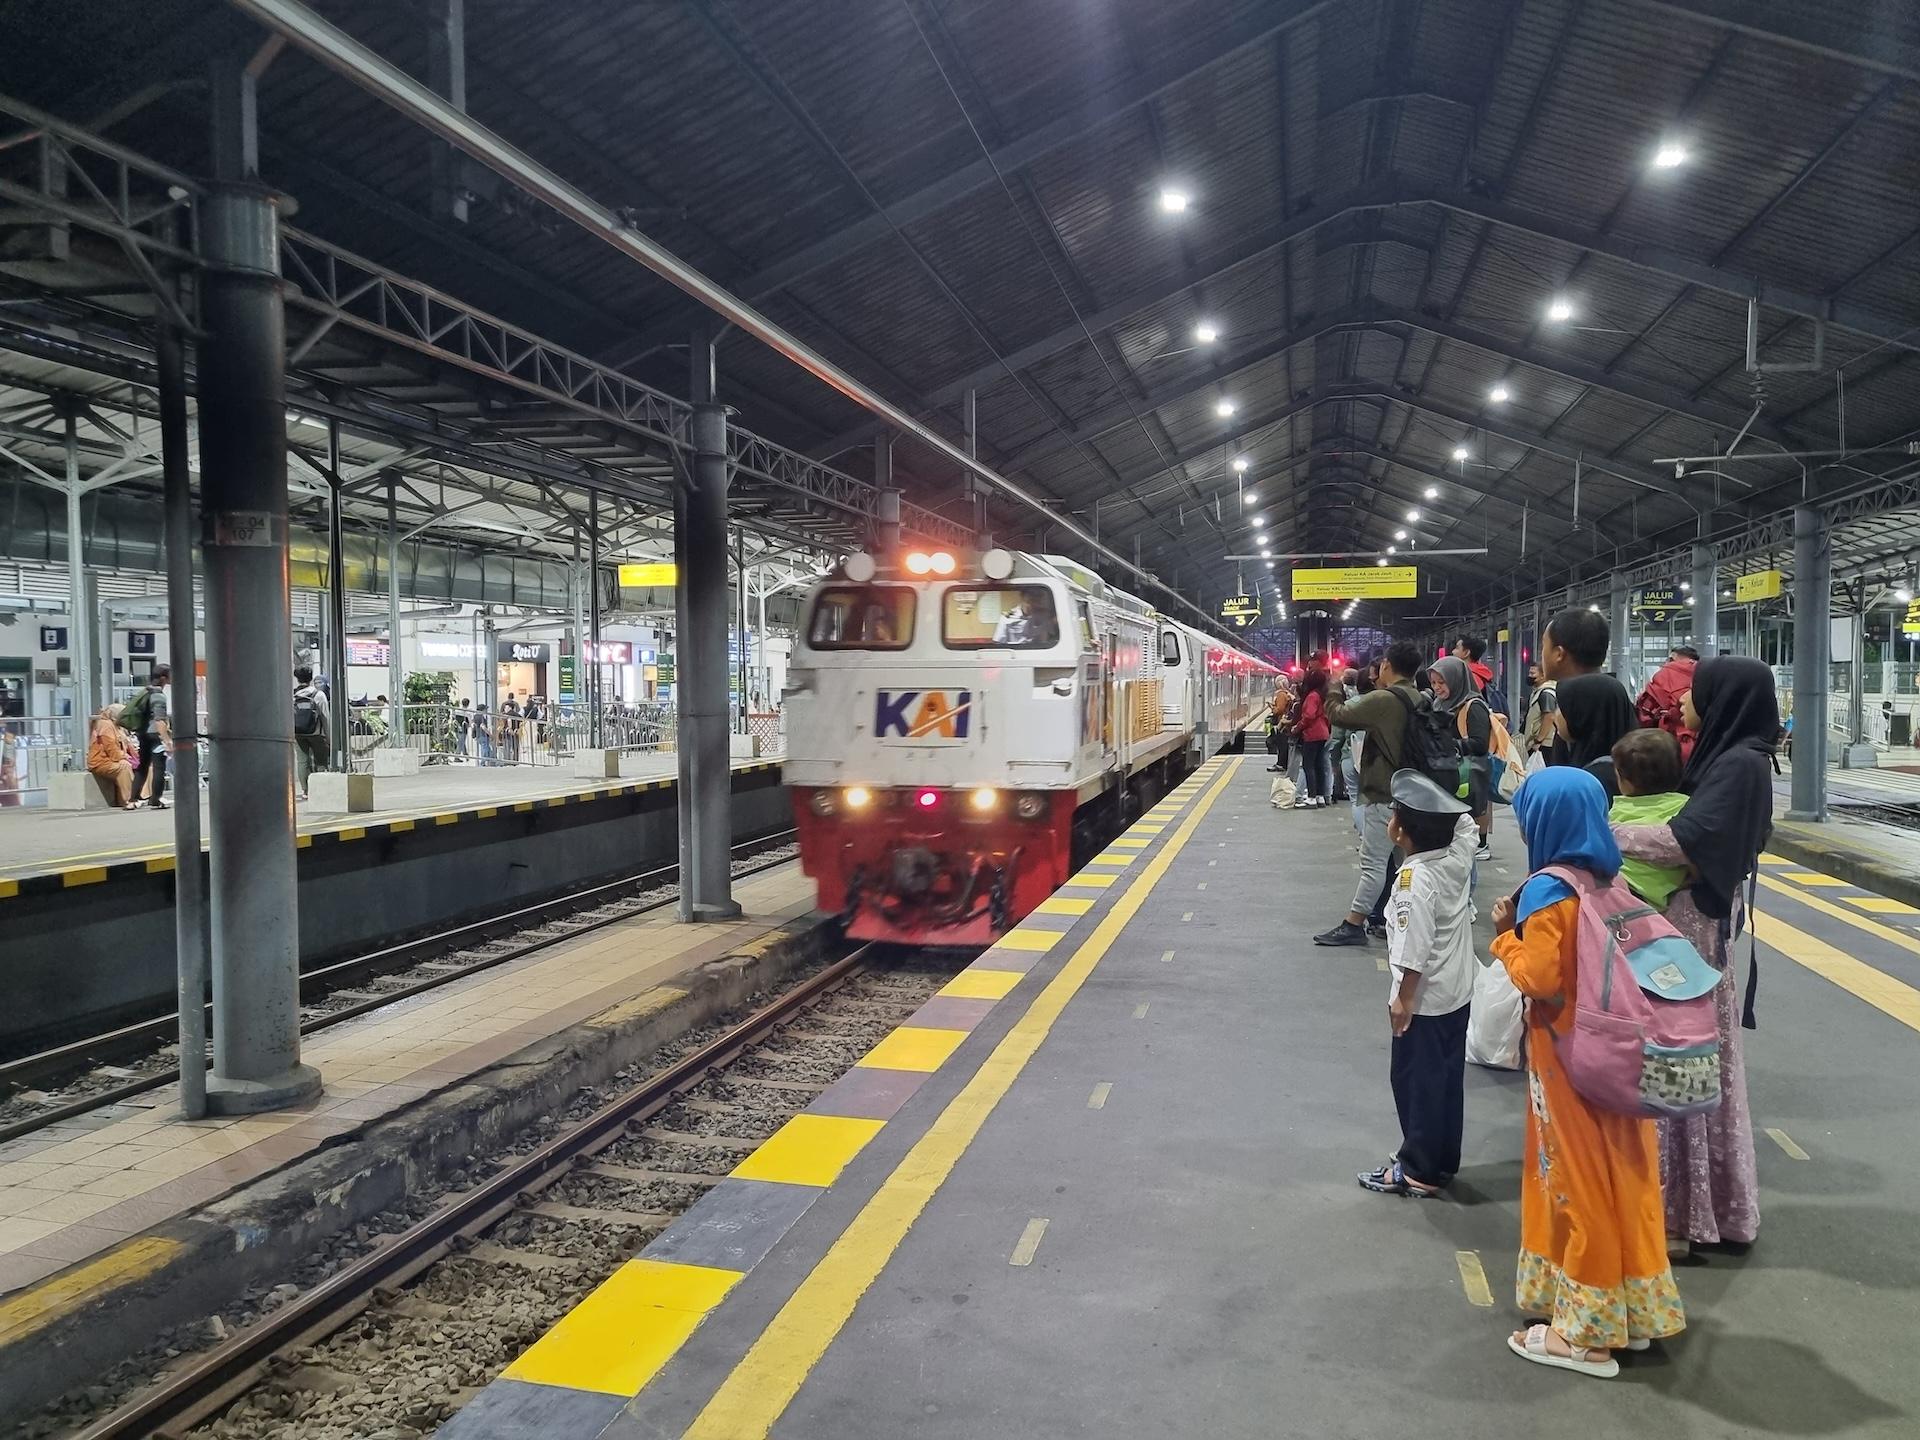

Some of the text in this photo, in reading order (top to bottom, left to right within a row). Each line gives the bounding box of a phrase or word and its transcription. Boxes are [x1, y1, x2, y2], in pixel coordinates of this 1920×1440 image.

[1644, 591, 1674, 600] JALUR
[1223, 597, 1250, 606] JALUR
[1235, 615, 1246, 626] 3
[1654, 611, 1666, 622] 2
[875, 691, 972, 738] KAI
